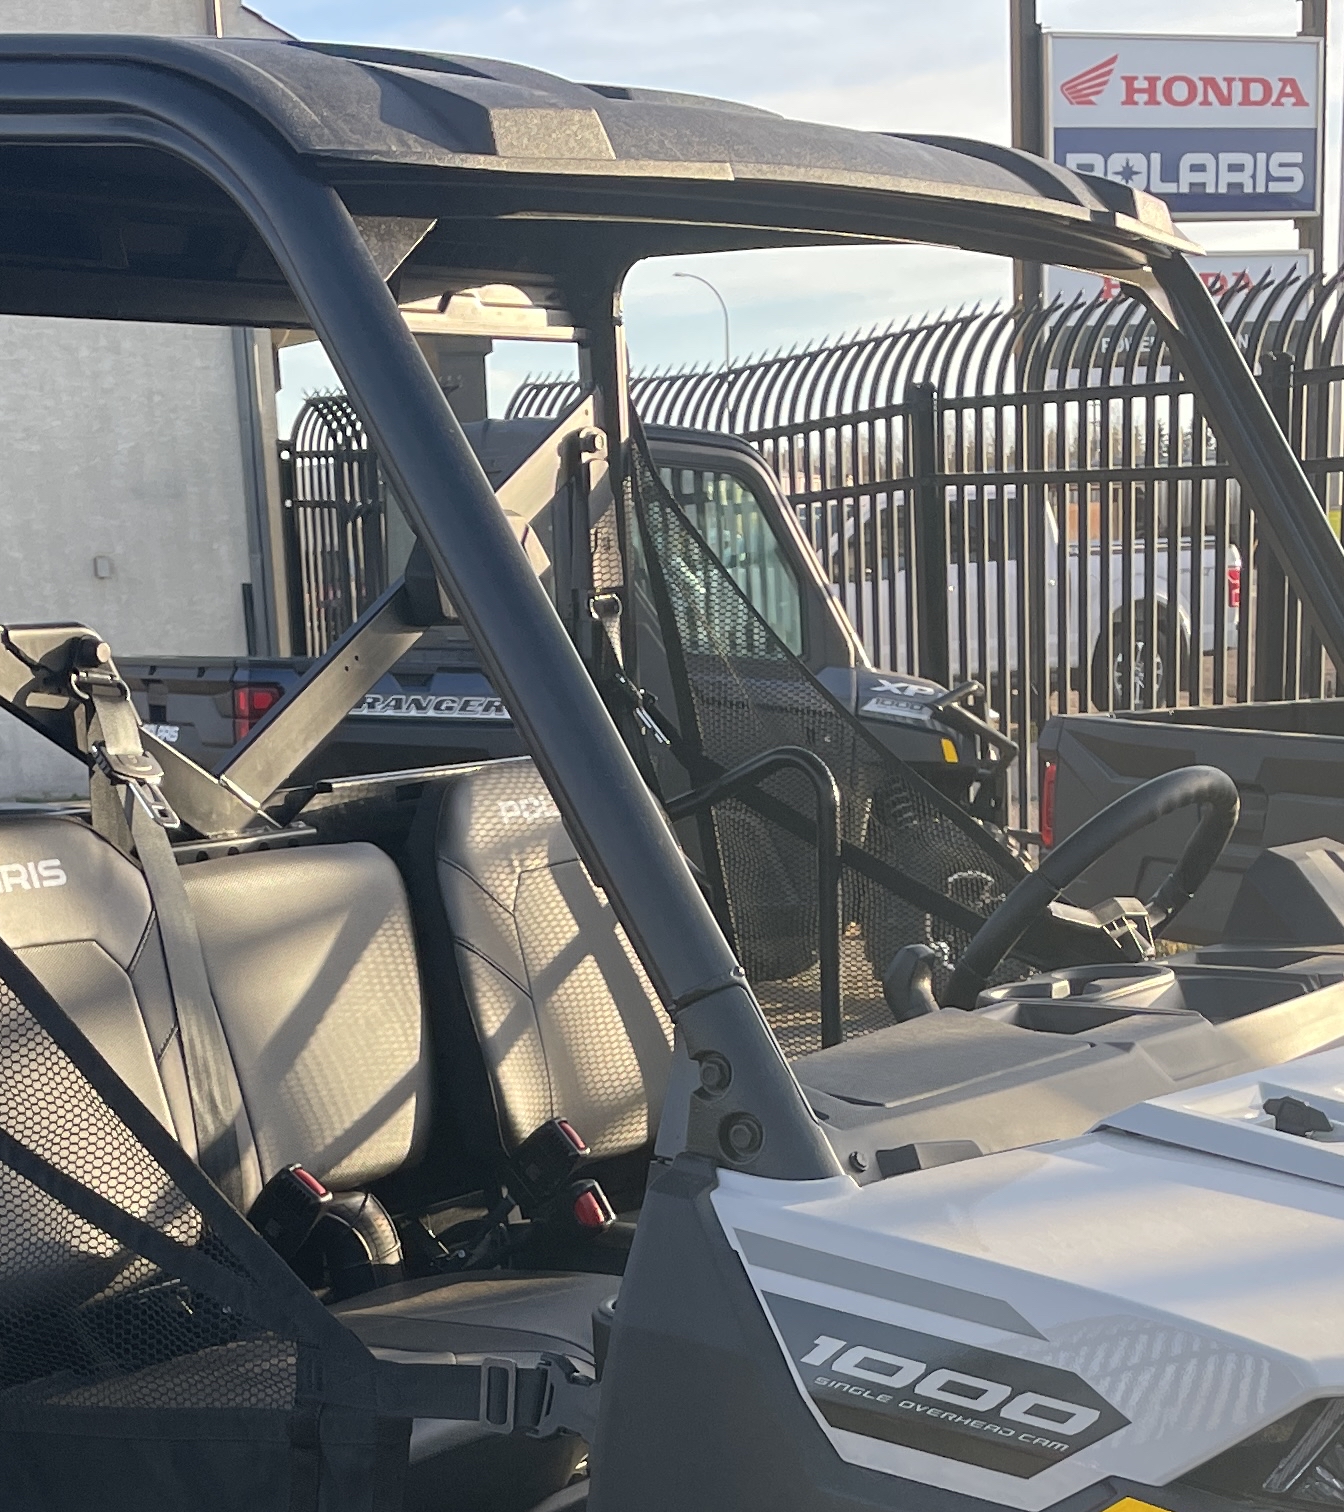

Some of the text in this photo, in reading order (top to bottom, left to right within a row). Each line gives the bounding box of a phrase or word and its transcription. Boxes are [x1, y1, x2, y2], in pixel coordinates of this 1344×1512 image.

[1120, 75, 1310, 107] HONDA
[1065, 151, 1305, 194] POLARIS
[870, 678, 935, 697] XP
[348, 694, 509, 717] RANGER
[876, 697, 923, 711] 1000
[799, 1335, 1101, 1436] 1000
[813, 1376, 1070, 1453] SINGLE OVERHEAD CAM
